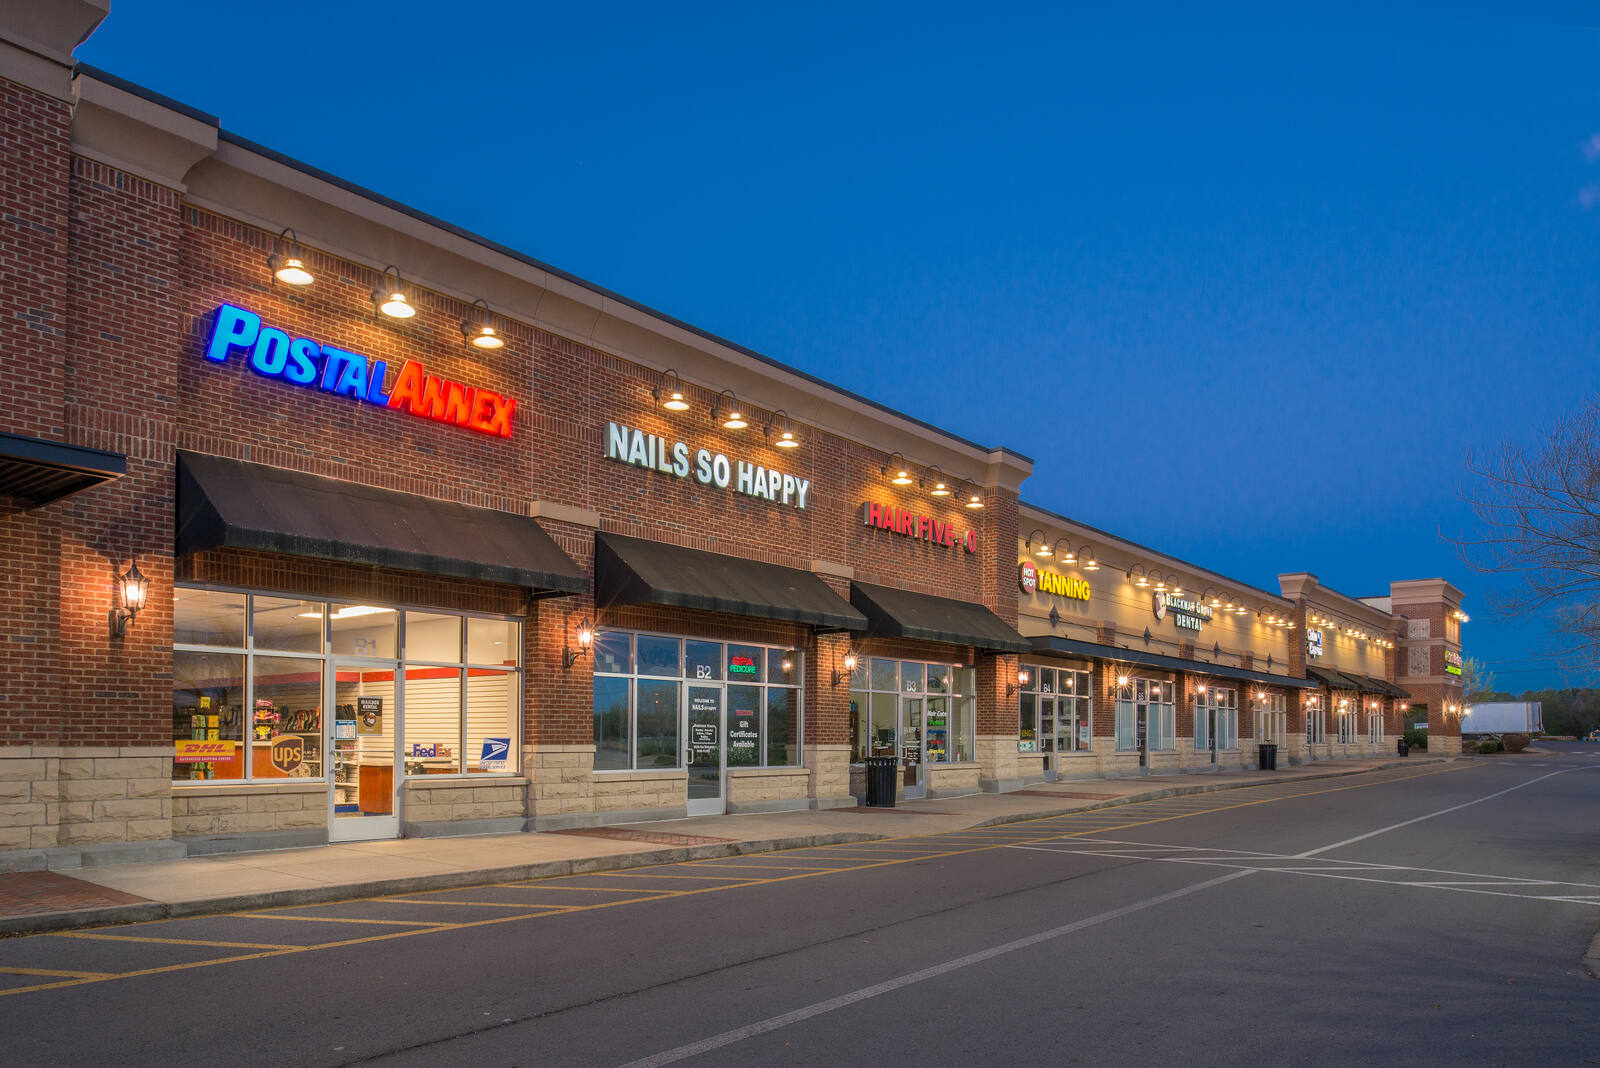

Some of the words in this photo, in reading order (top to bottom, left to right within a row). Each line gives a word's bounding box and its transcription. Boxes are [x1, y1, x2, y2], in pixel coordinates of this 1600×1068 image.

[607, 422, 689, 477] NAILS
[697, 449, 730, 488] SO
[738, 460, 809, 509] HAPPY
[868, 501, 913, 536] HAIR
[1023, 567, 1034, 577] HOT
[1023, 577, 1036, 587] SPOT
[1038, 568, 1090, 601] TANNING
[1176, 613, 1203, 631] DENTAL
[355, 638, 376, 656] B1
[733, 656, 754, 666] SPA
[696, 664, 712, 679] B2
[730, 664, 756, 673] PEDICURE
[906, 680, 917, 692] B3
[1043, 683, 1051, 693] B4
[739, 720, 749, 728] Gift
[730, 730, 758, 738] Certificates
[184, 743, 227, 753] DHL
[733, 740, 755, 748] Available
[413, 743, 453, 757] FedEx
[273, 746, 302, 768] ups
